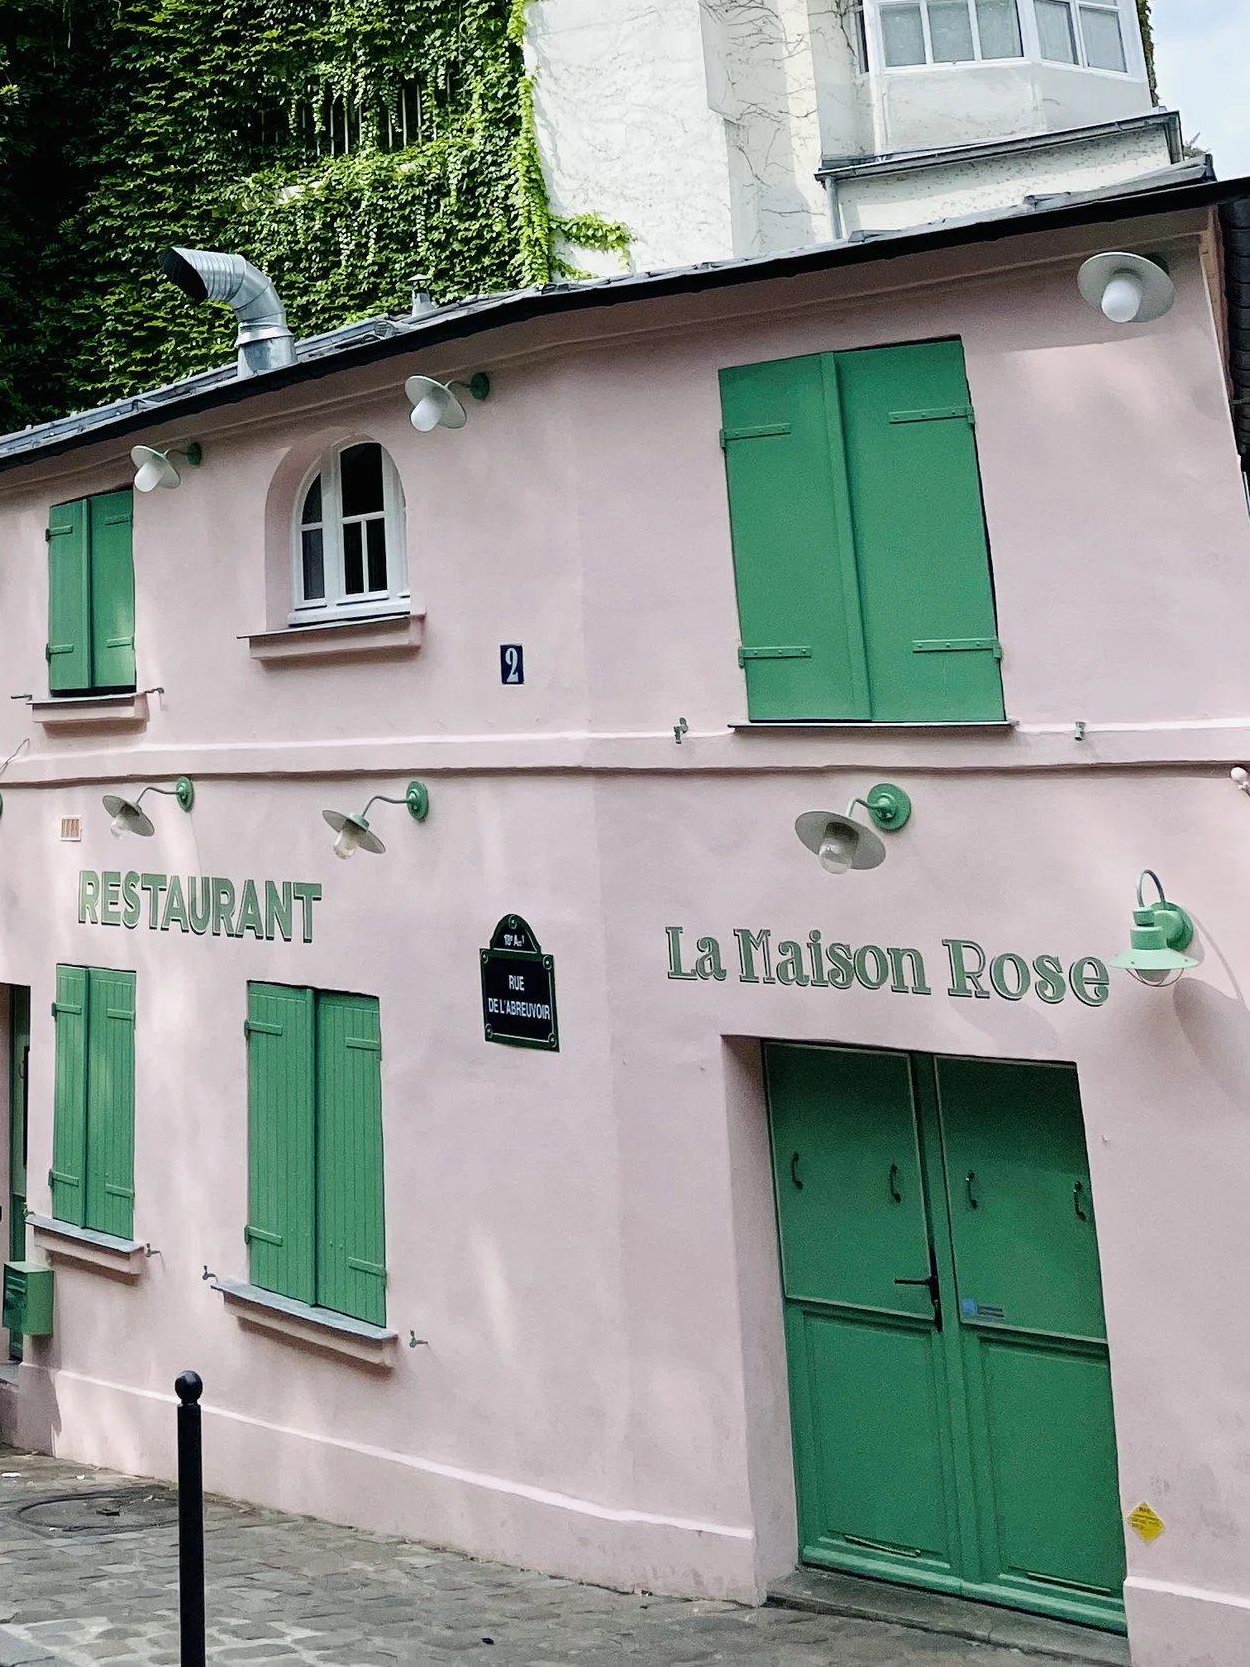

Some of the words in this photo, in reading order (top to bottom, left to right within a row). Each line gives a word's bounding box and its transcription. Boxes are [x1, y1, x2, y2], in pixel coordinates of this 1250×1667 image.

[505, 647, 519, 683] 2
[78, 870, 322, 943] RESTAURANT
[508, 974, 525, 991] RUE
[665, 926, 727, 980] La
[733, 928, 931, 995] Maison
[942, 938, 1110, 1007] Rose
[488, 997, 499, 1014] DE
[499, 998, 551, 1021] L'ABREUVOIR
